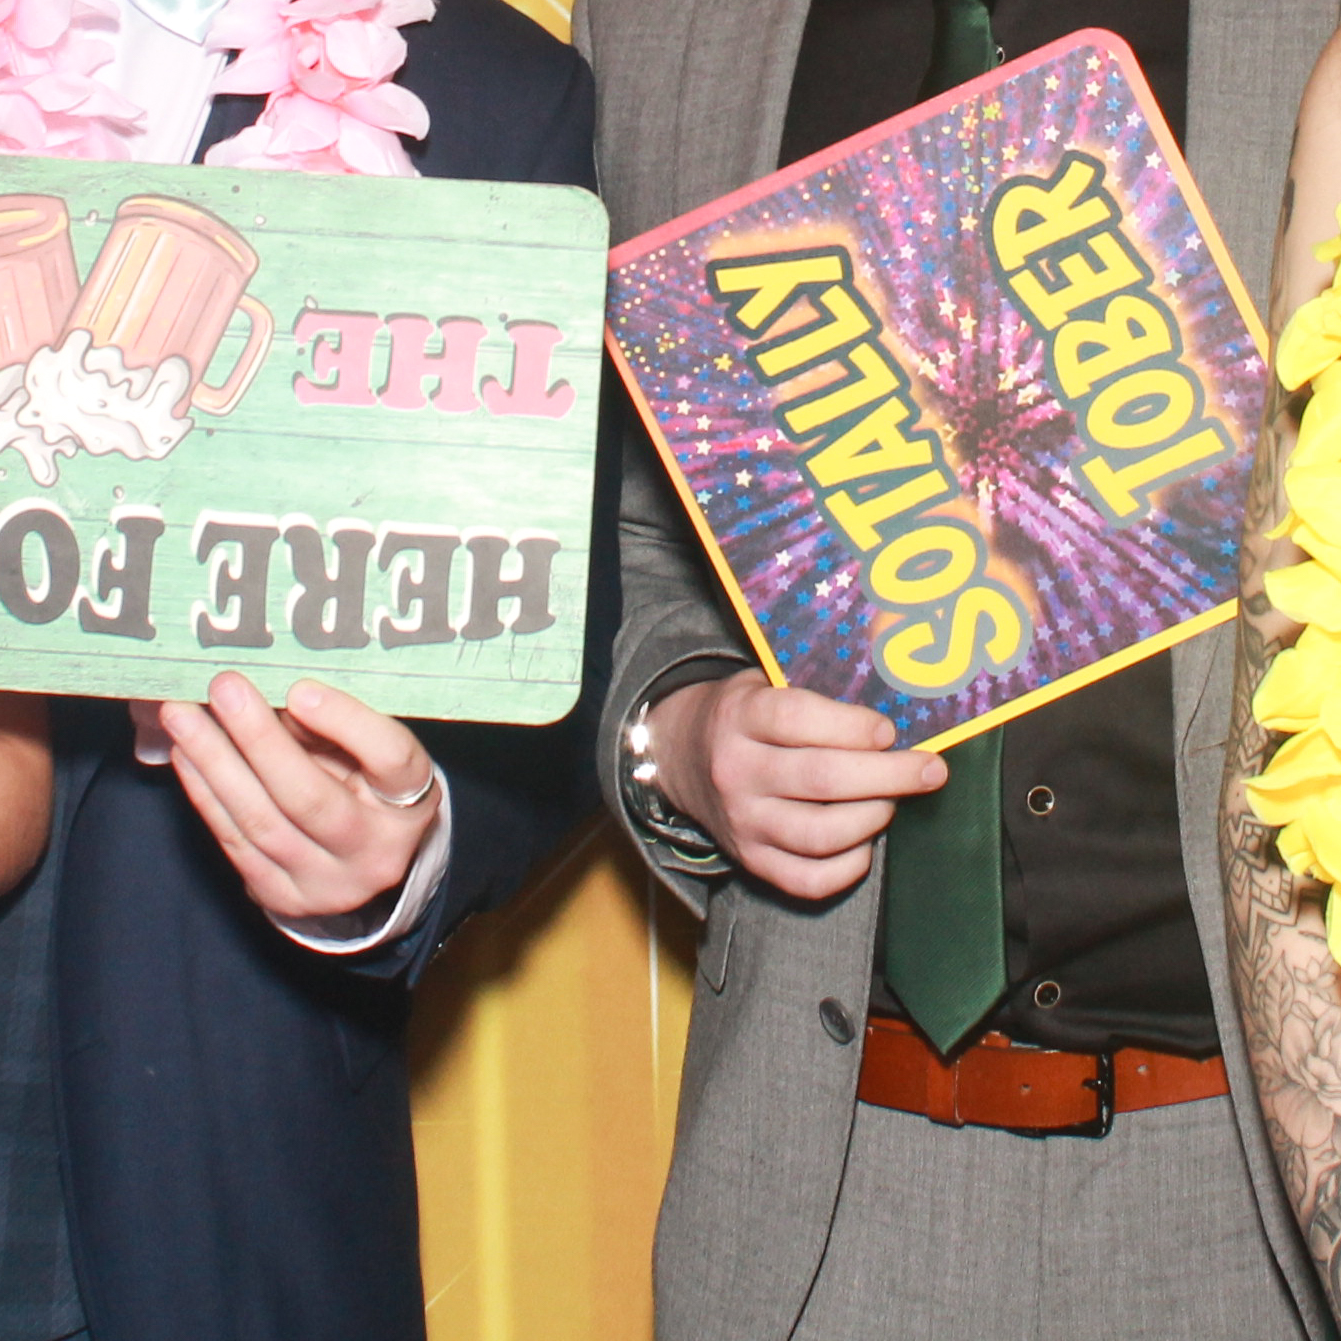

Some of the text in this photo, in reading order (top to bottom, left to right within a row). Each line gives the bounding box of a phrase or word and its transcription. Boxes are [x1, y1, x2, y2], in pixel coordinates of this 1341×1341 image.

[293, 307, 577, 419] THE
[986, 152, 1233, 526] TOBER
[191, 510, 562, 651] HERE
[708, 247, 1031, 696] SOTALLY
